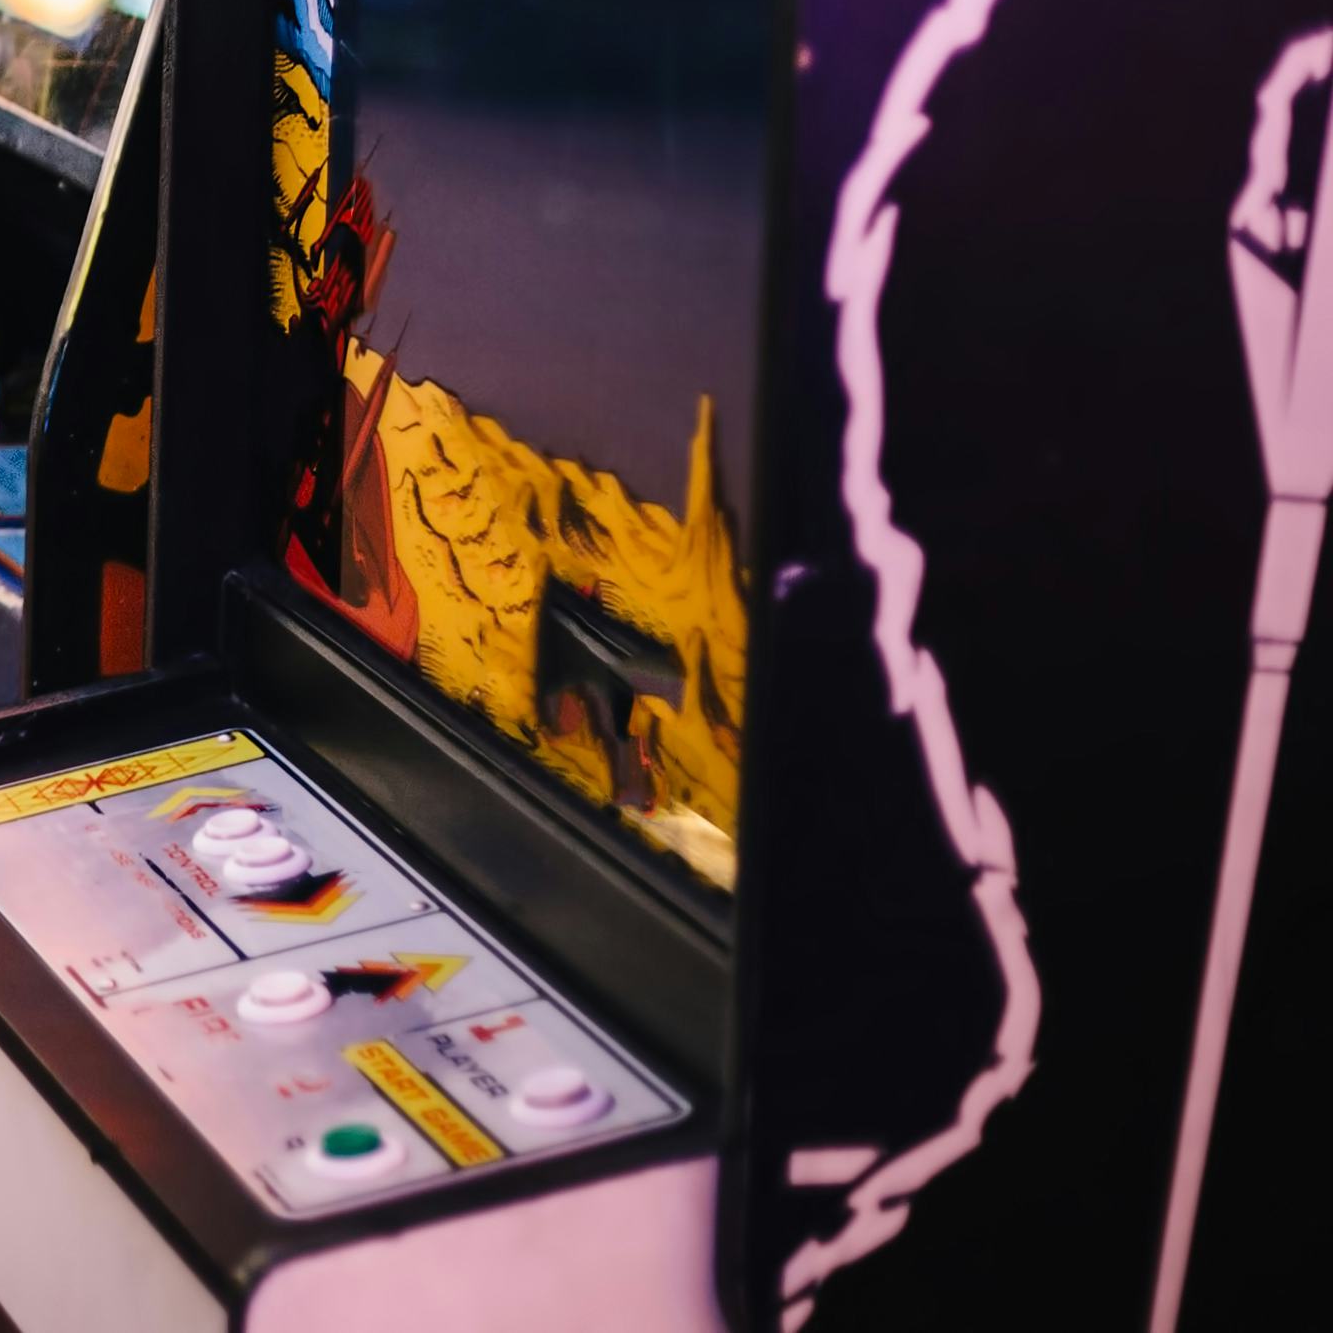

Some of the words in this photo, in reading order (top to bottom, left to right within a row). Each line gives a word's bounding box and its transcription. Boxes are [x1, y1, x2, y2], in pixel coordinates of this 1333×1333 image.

[162, 842, 221, 897] CONTROL
[425, 1033, 510, 1099] PLAYER
[357, 1045, 429, 1101] START
[420, 1108, 494, 1163] GAME
